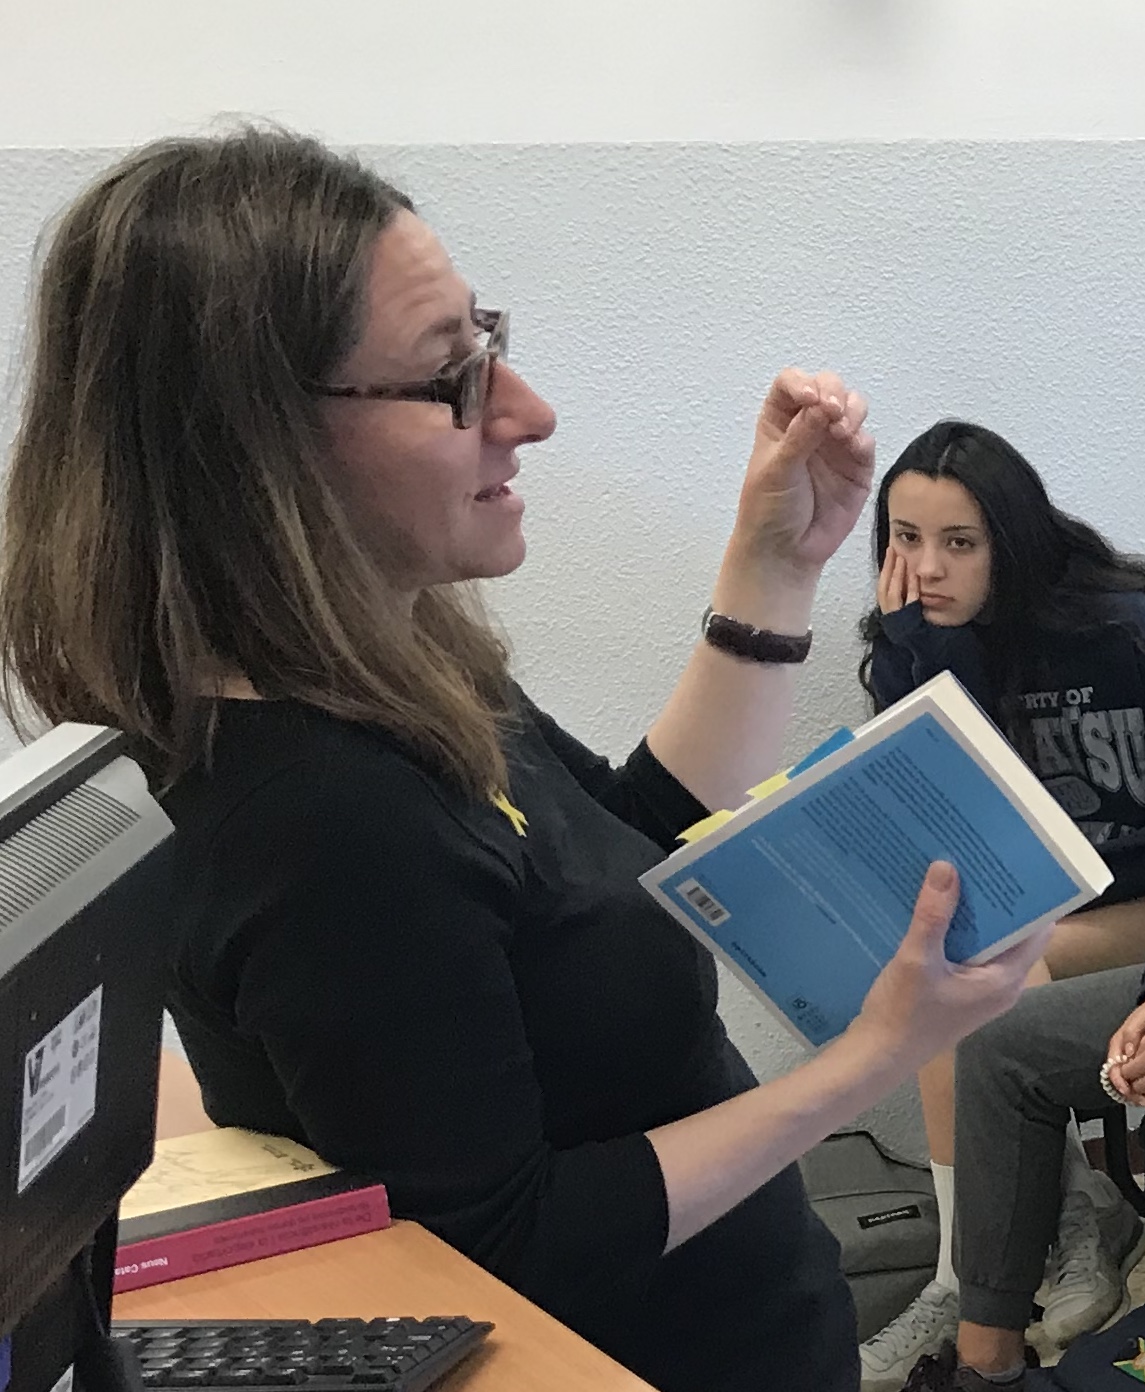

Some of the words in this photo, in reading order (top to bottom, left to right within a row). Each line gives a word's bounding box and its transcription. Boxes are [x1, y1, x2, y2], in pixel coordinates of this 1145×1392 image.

[1019, 691, 1060, 710] RTY
[1065, 686, 1094, 705] OF
[114, 1262, 139, 1276] Cata
